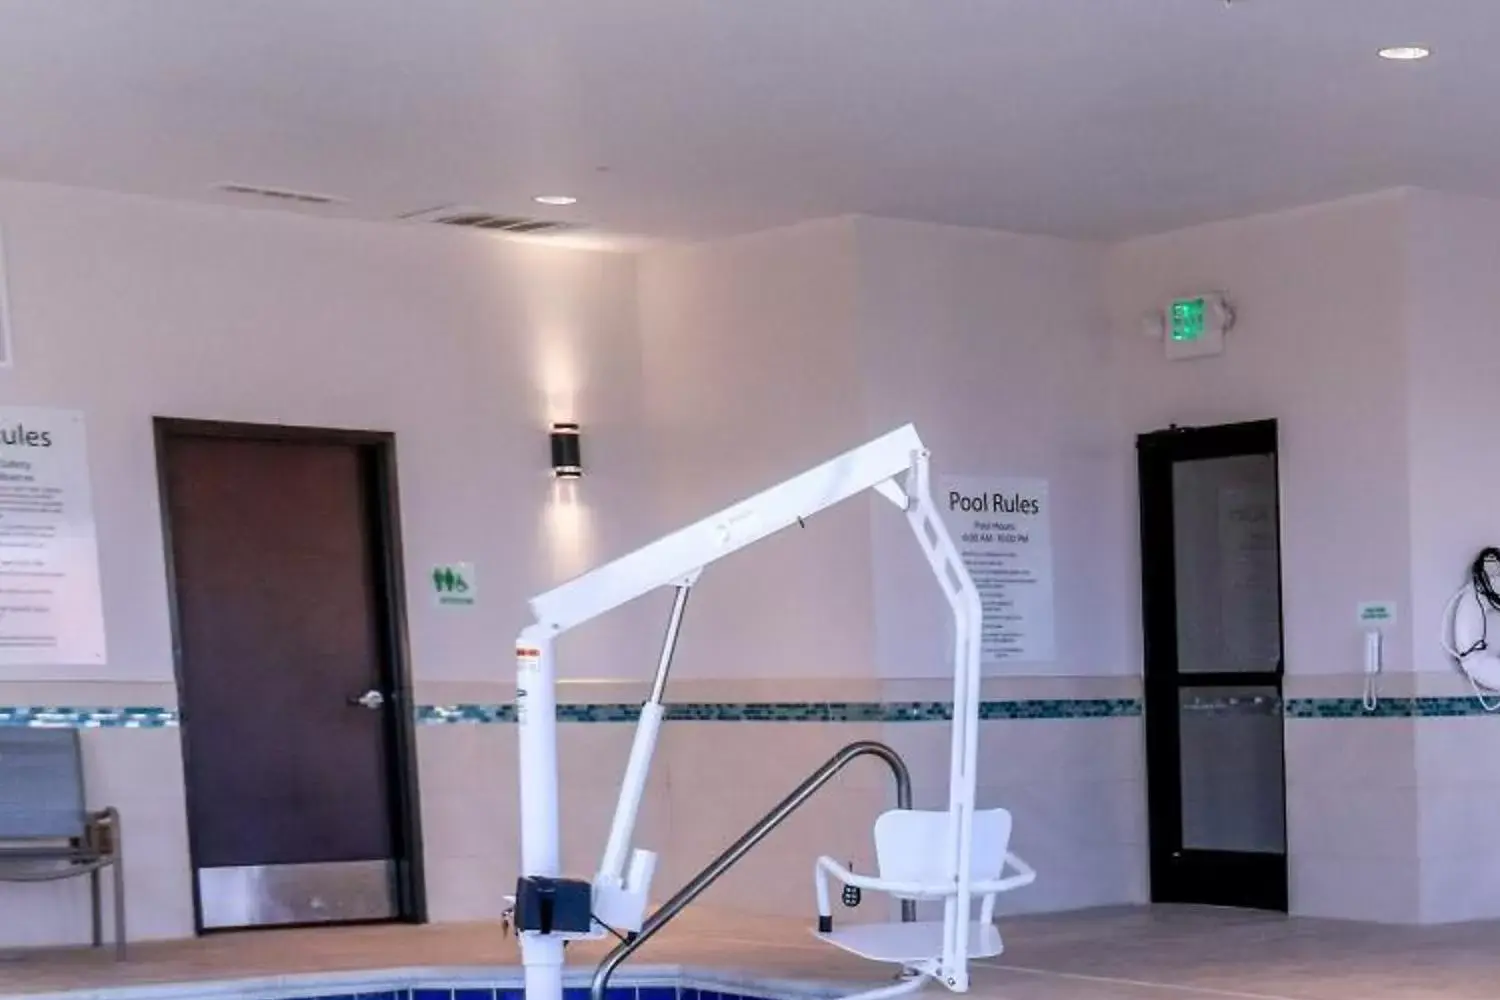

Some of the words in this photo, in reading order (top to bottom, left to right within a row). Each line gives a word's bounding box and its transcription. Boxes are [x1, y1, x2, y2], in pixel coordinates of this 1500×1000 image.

[0, 422, 52, 448] ules
[949, 491, 988, 512] Pool
[993, 493, 1039, 515] Rules
